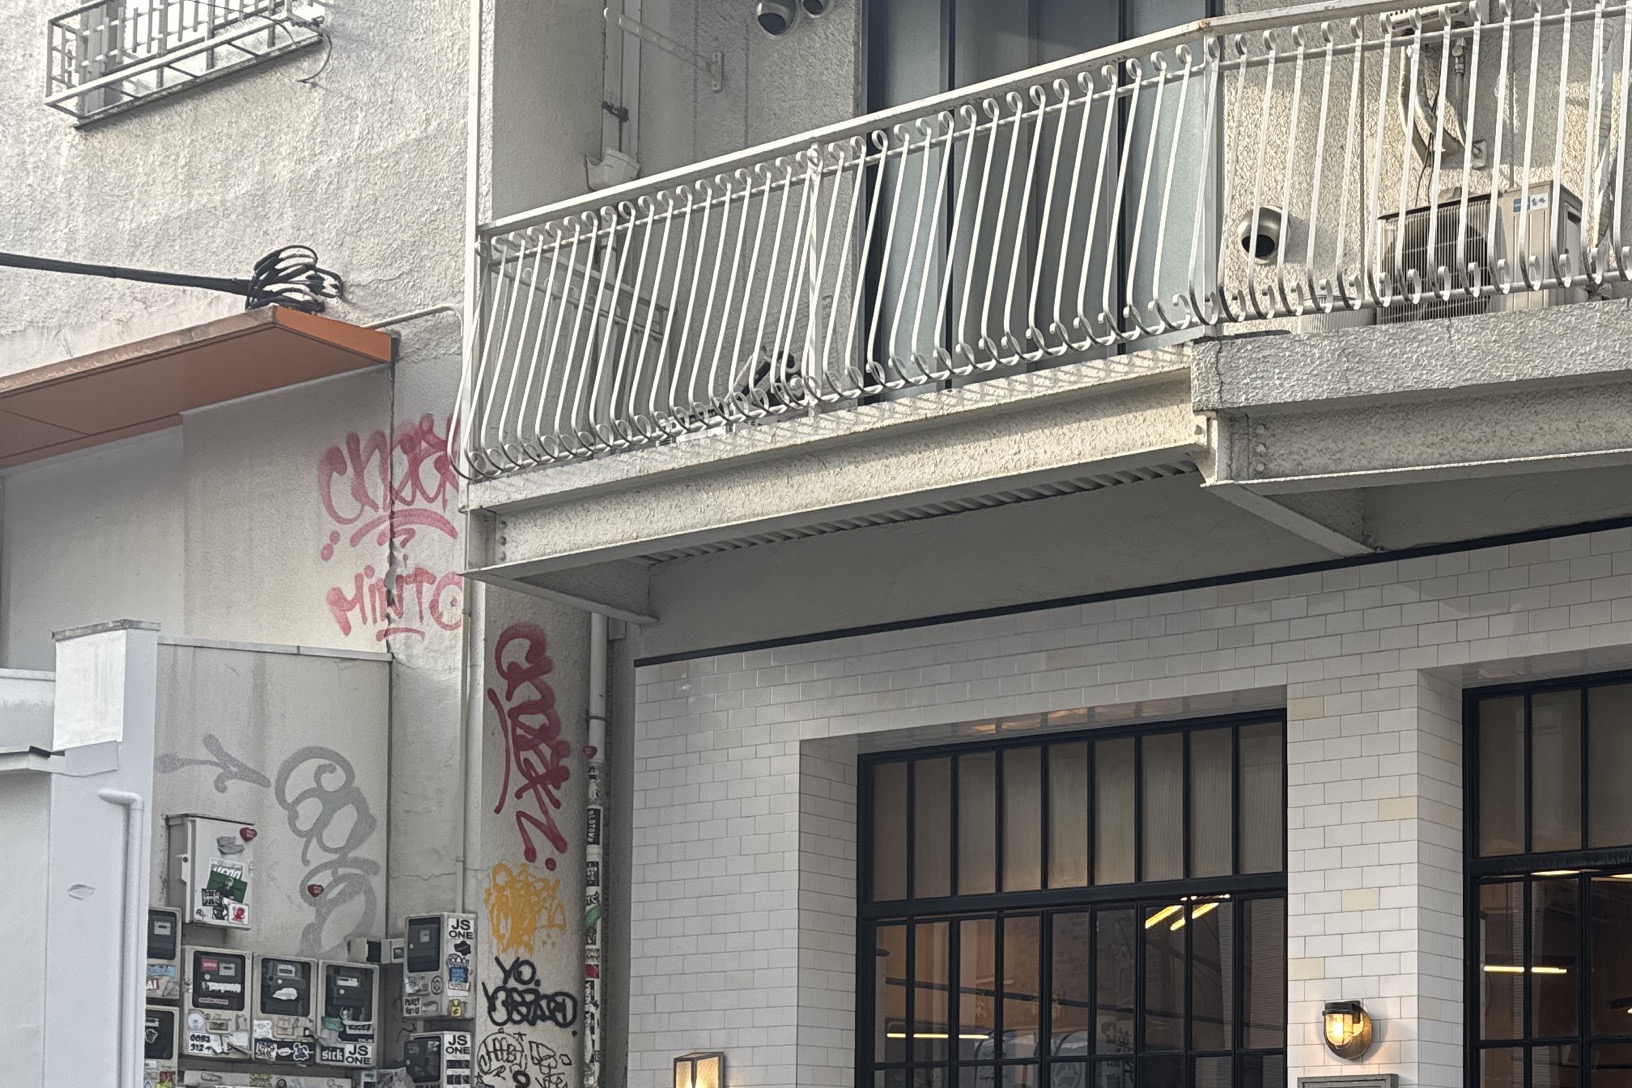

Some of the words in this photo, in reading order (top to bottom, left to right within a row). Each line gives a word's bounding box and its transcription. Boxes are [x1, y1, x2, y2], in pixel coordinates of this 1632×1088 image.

[451, 919, 471, 930] JS
[449, 931, 474, 940] ONE
[448, 1035, 468, 1046] JS
[322, 1048, 343, 1061] sick
[349, 1044, 369, 1056] JS
[446, 1047, 471, 1055] ONE
[346, 1056, 372, 1065] ONE
